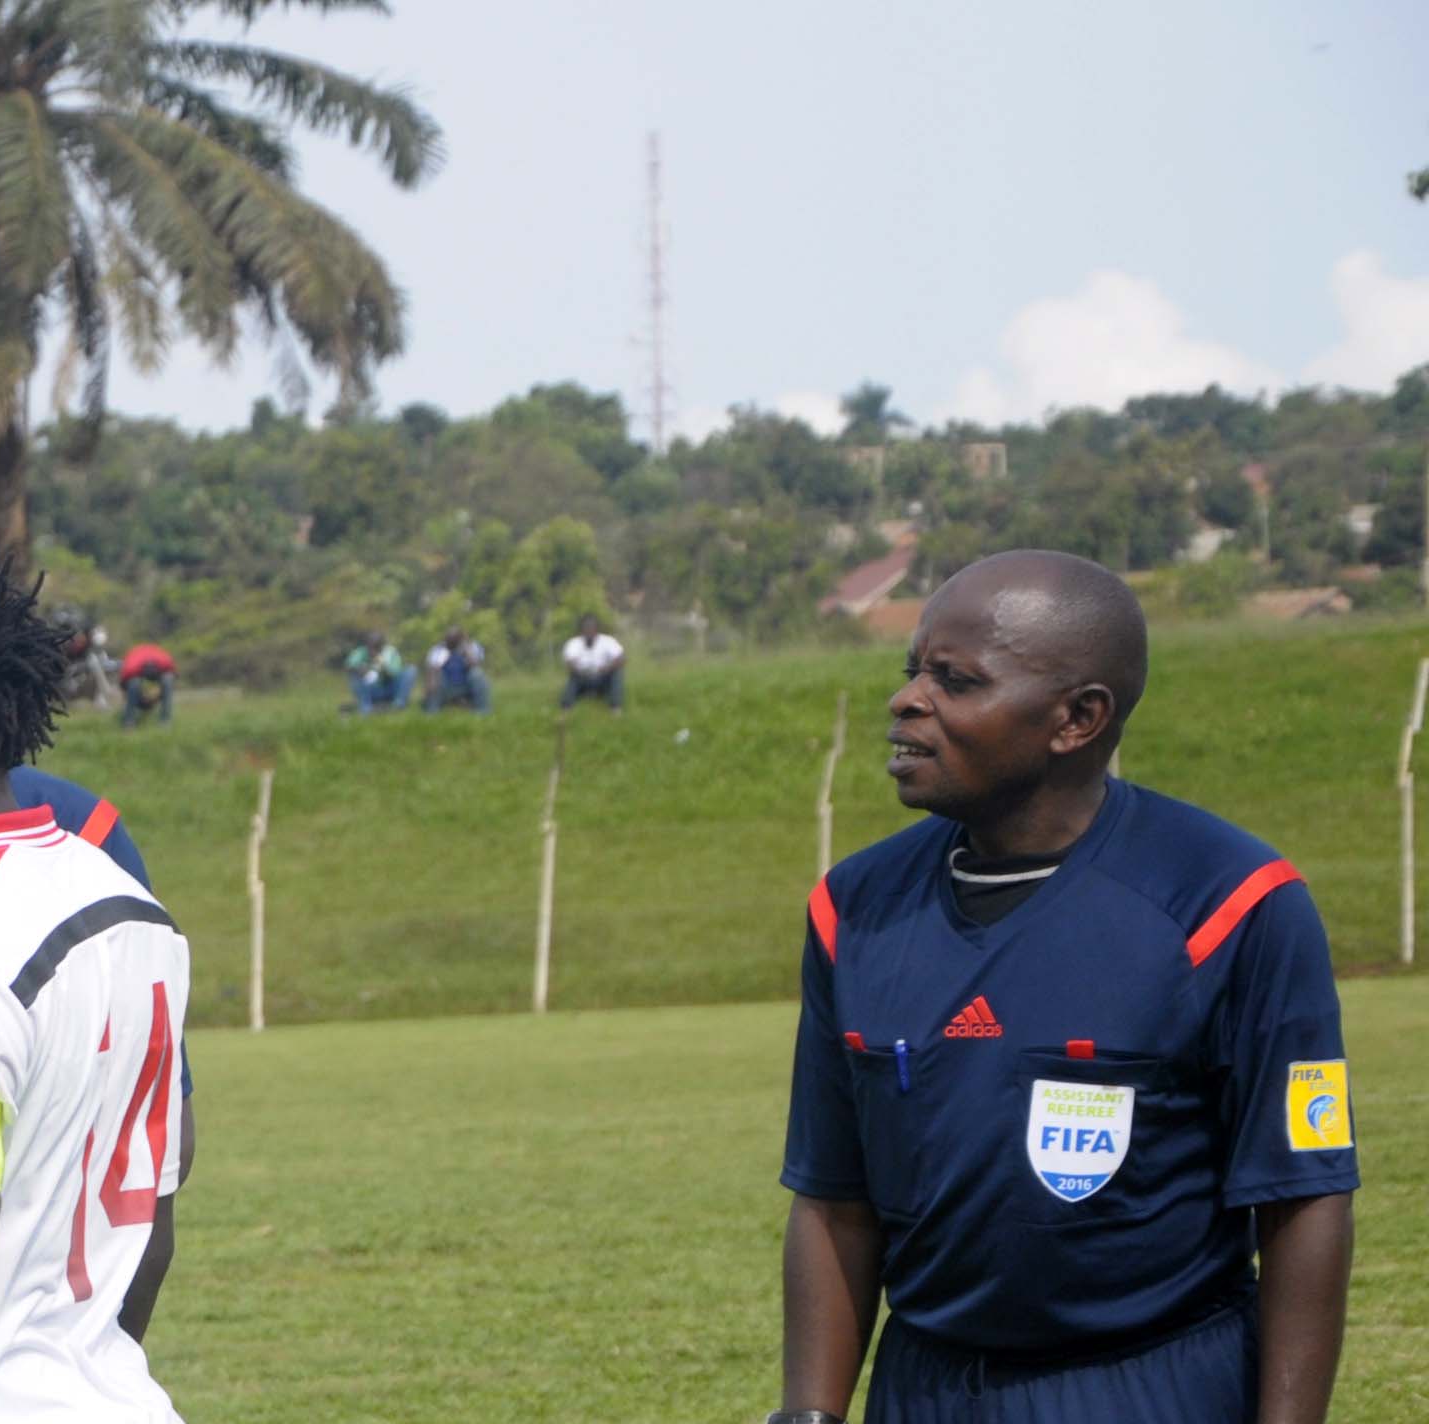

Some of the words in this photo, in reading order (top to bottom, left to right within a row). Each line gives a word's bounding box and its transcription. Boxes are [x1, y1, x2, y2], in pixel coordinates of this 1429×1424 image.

[944, 1019, 1003, 1039] adidas
[1292, 1069, 1325, 1082] FIFA
[1042, 1088, 1126, 1104] ASSISTANT
[1047, 1102, 1117, 1118] REFEREE
[1040, 1125, 1116, 1154] FIFA
[1057, 1177, 1093, 1191] 2016
